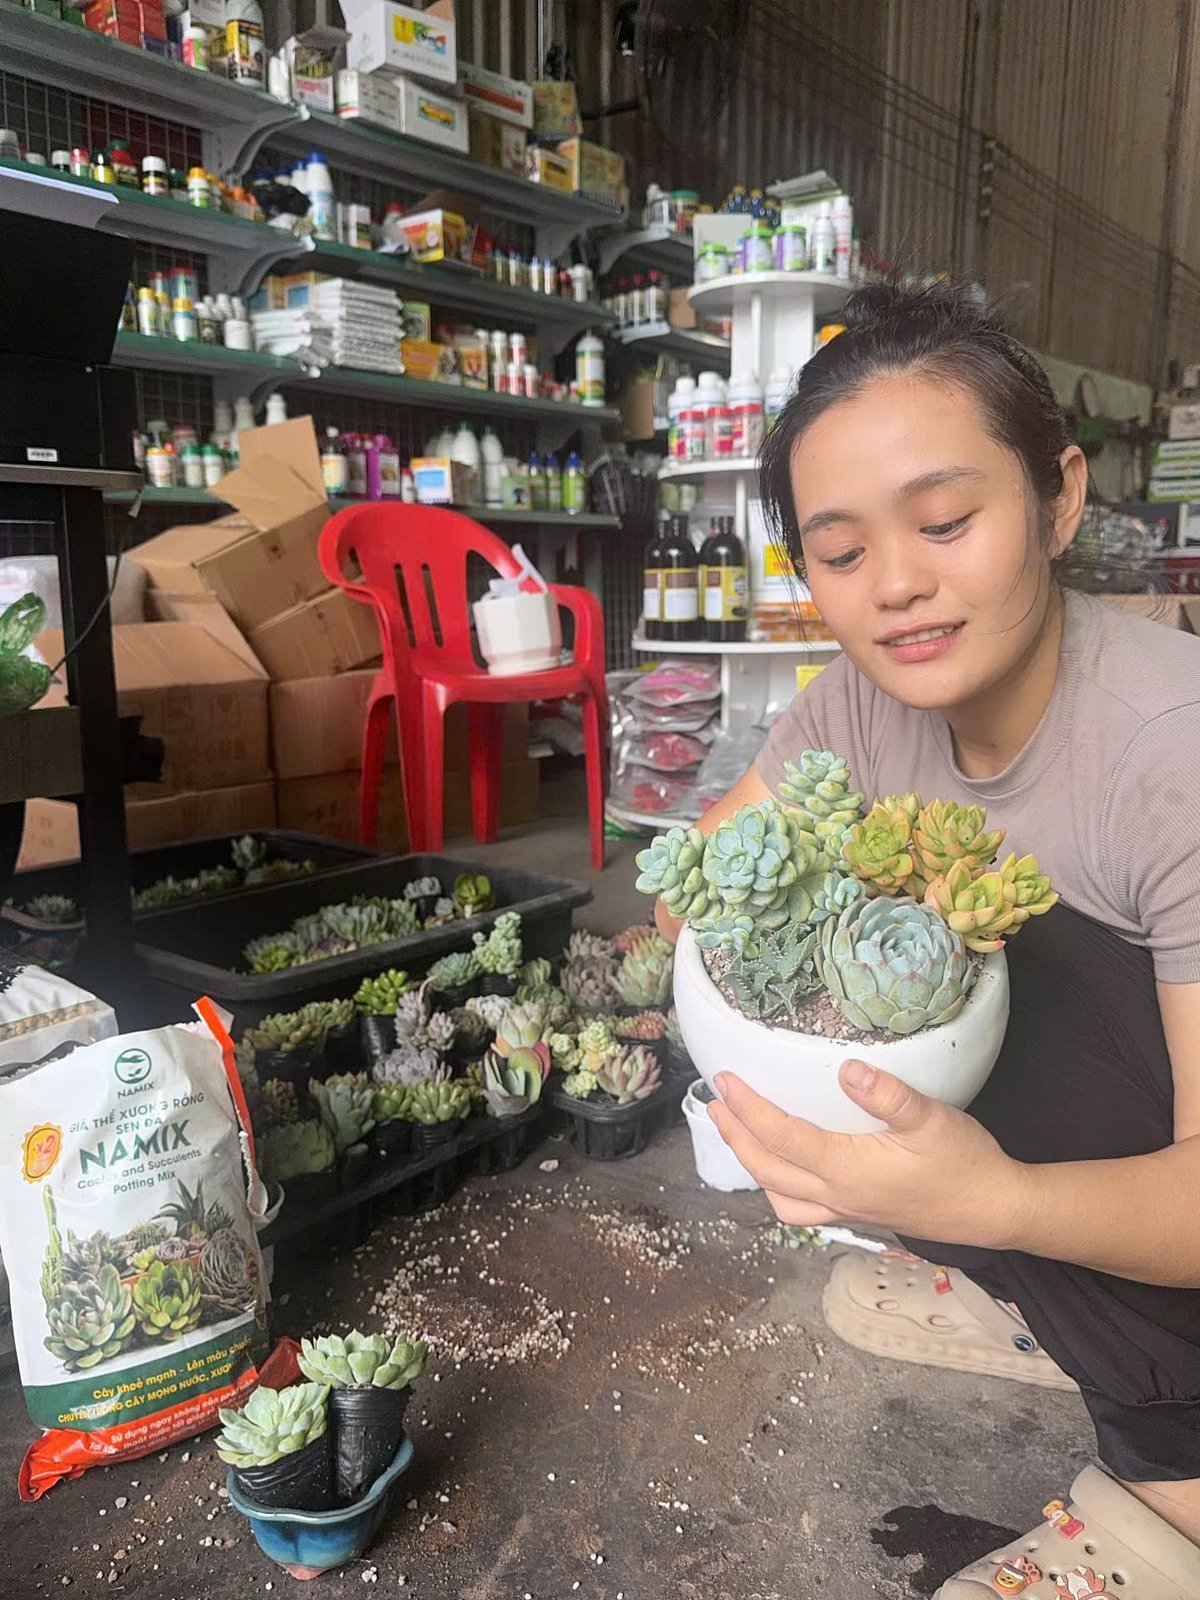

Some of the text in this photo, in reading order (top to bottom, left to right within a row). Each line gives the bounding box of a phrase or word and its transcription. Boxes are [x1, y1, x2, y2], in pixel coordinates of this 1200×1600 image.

[117, 1081, 155, 1099] NAMIX
[79, 1118, 192, 1174] NAMIX
[116, 1120, 140, 1135] SEN
[78, 1148, 202, 1190] Cact and Succulents
[113, 1170, 177, 1195] Potting Mix
[93, 1387, 115, 1400] Cây
[146, 1368, 177, 1386] mạnh
[186, 1359, 205, 1372] Lên
[206, 1348, 228, 1364] màu
[125, 1394, 145, 1409] CÂY
[147, 1384, 178, 1401] MỌNG
[210, 1362, 233, 1379] XƯƠ
[124, 1425, 149, 1440] dụng
[149, 1416, 172, 1430] ngay
[173, 1403, 200, 1419] không
